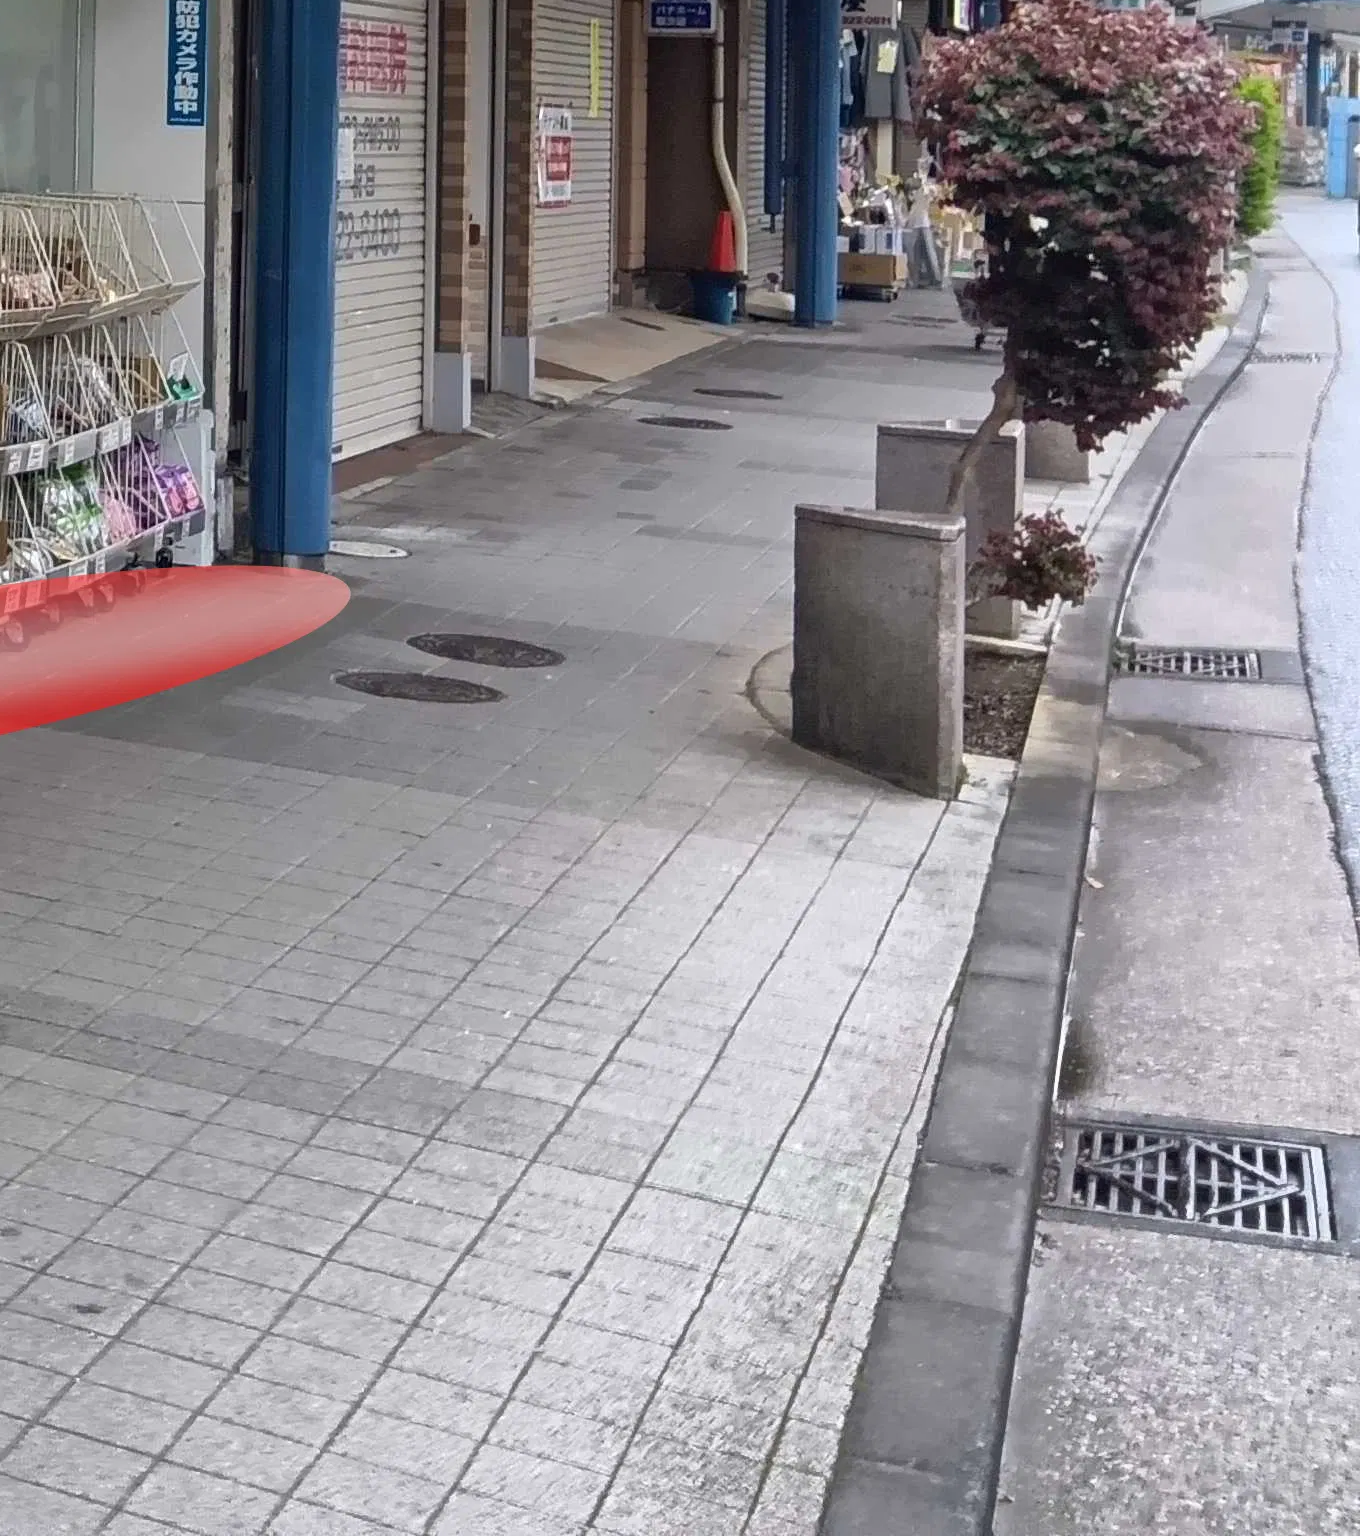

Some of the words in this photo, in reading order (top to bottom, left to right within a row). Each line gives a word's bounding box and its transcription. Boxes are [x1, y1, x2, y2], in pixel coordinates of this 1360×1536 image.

[174, 0, 201, 115] 防犯カメラ作動中
